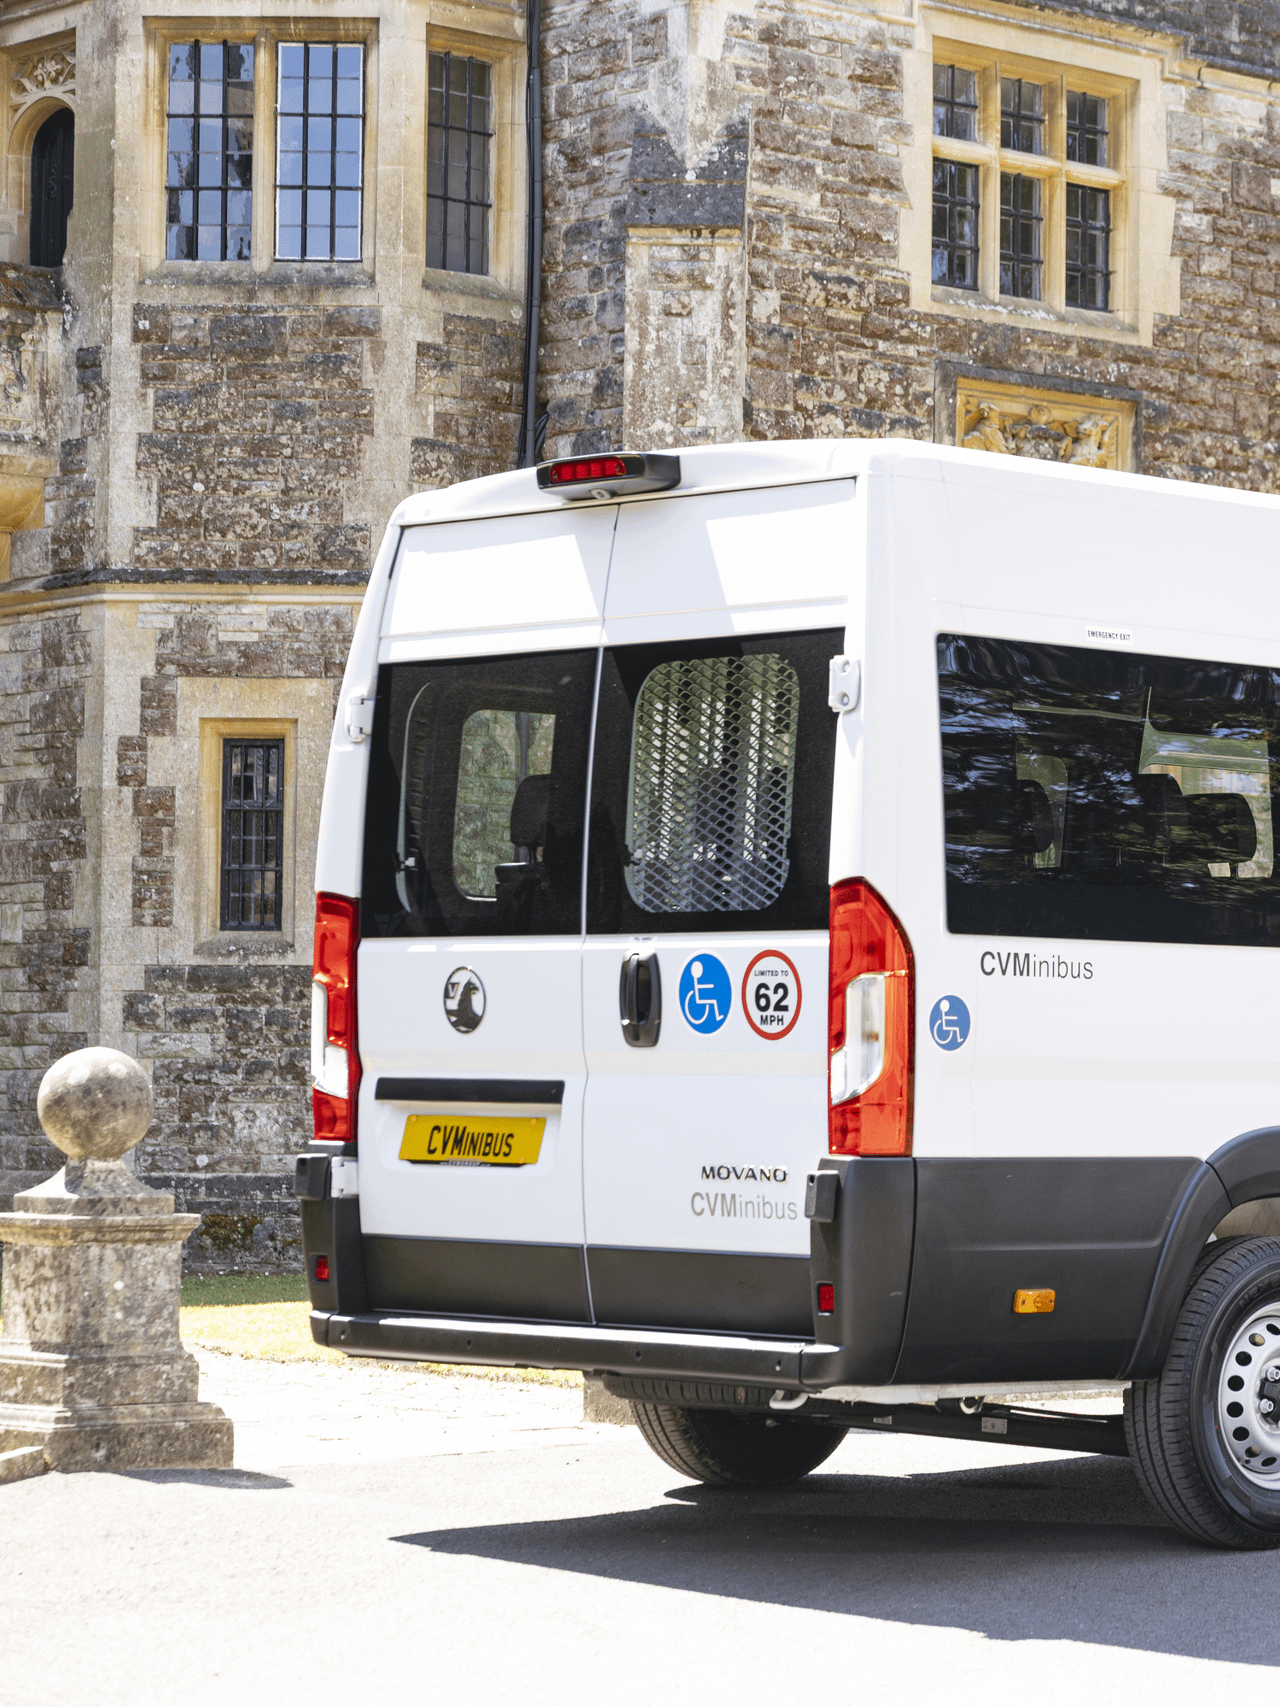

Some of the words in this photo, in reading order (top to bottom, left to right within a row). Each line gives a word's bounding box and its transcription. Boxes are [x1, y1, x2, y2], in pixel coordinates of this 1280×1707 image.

[1088, 630, 1118, 639] EMERGENCY
[754, 969, 779, 977] LIMITED
[780, 969, 789, 977] TO
[980, 951, 1094, 980] CVMinibus
[754, 982, 790, 1013] 62
[760, 1014, 784, 1026] MPH
[701, 1165, 788, 1183] MOVANO
[690, 1191, 798, 1221] CVMinibus
